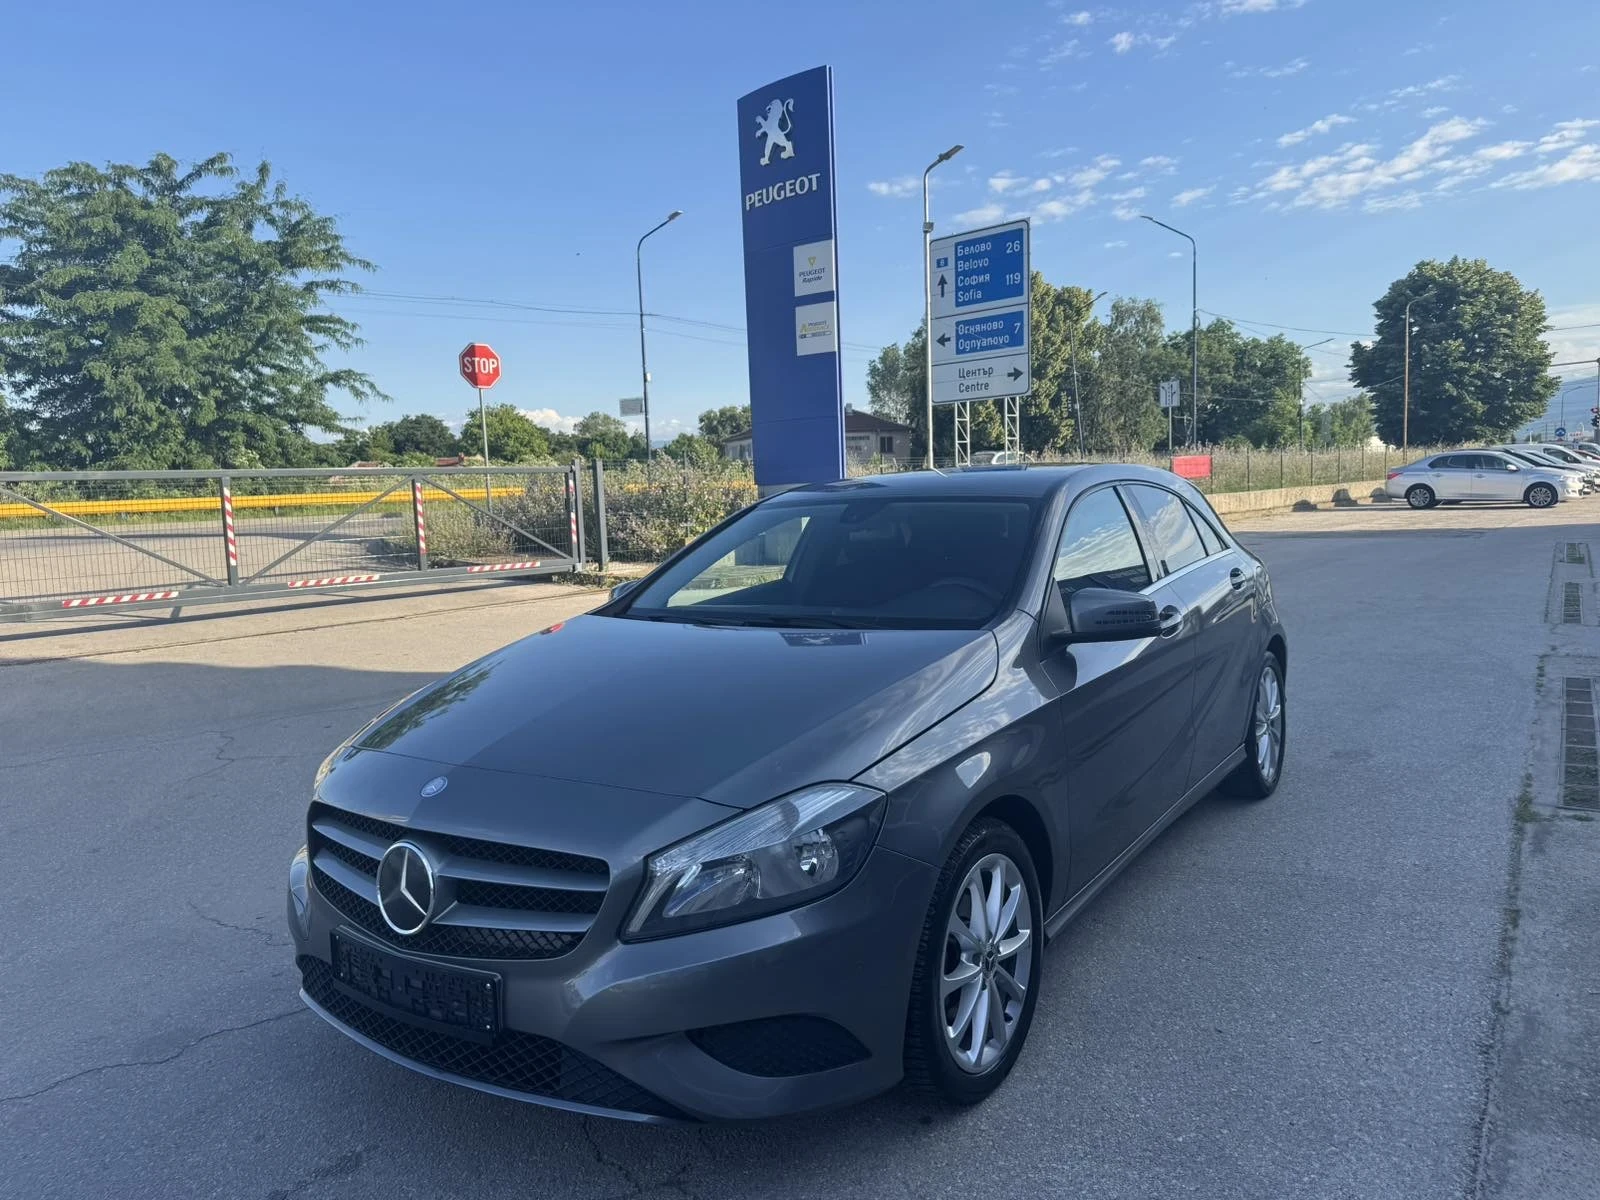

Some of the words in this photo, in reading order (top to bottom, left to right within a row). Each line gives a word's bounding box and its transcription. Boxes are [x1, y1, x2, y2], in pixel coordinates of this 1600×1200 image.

[745, 173, 821, 211] PEUGEOT
[957, 242, 992, 256] Белово
[1006, 240, 1020, 254] 26
[799, 267, 825, 278] PEUGEOT
[957, 258, 989, 272] Belovo
[958, 273, 990, 287] София
[1006, 272, 1021, 286] 119
[958, 288, 982, 302] Sofia
[958, 320, 1004, 335] Огняново
[1014, 322, 1020, 334] 7
[958, 335, 1010, 351] Ognyanovo
[464, 357, 498, 374] STOP
[958, 366, 994, 380] Център
[958, 381, 990, 393] Centre
